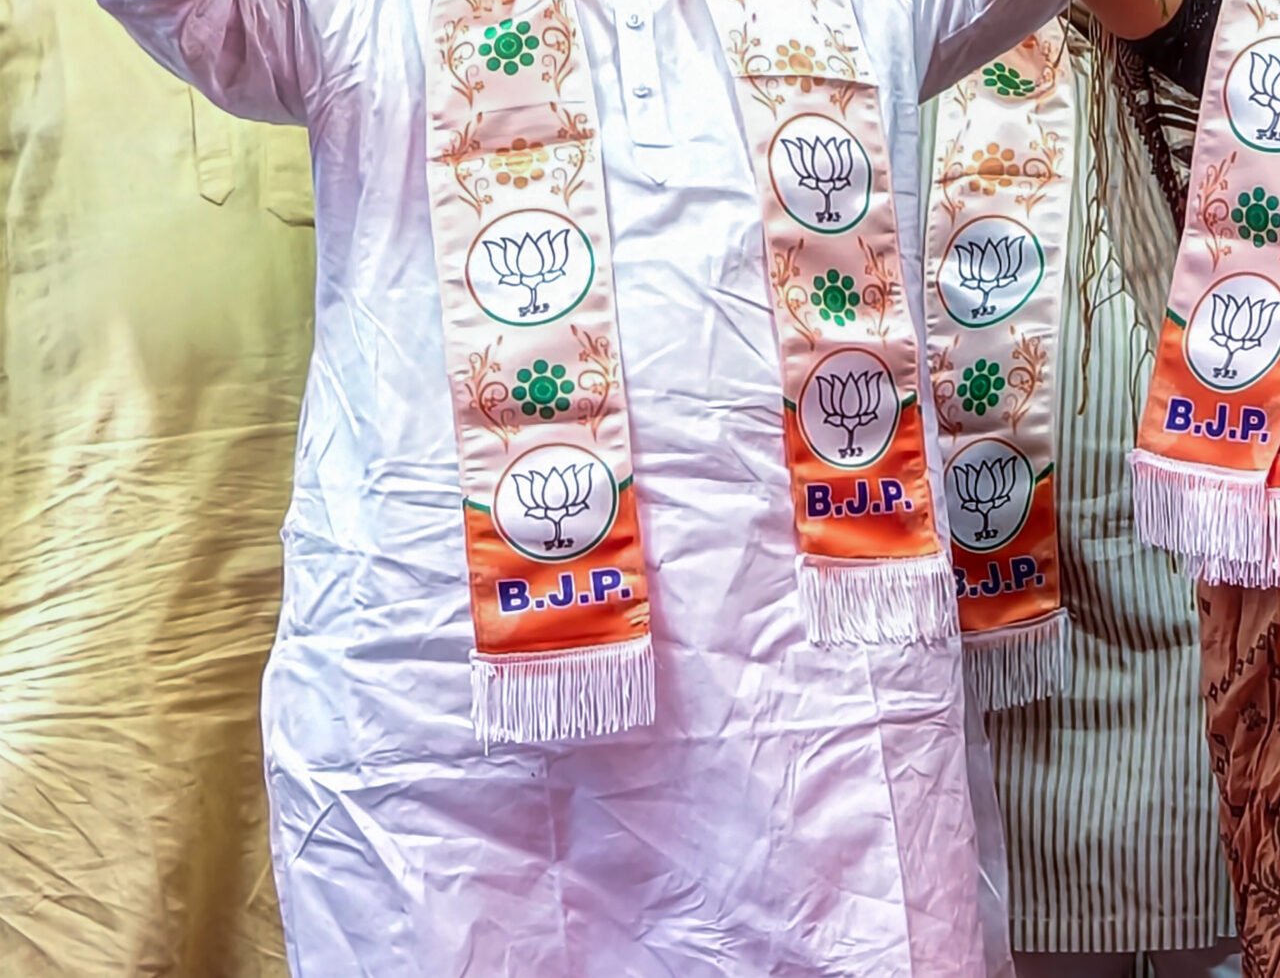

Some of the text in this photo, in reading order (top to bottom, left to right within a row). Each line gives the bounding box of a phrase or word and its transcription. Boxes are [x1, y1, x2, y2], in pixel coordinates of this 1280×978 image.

[1164, 397, 1270, 443] B.J.P.
[806, 479, 912, 517] B.J.P.
[496, 569, 632, 613] B.J.P.
